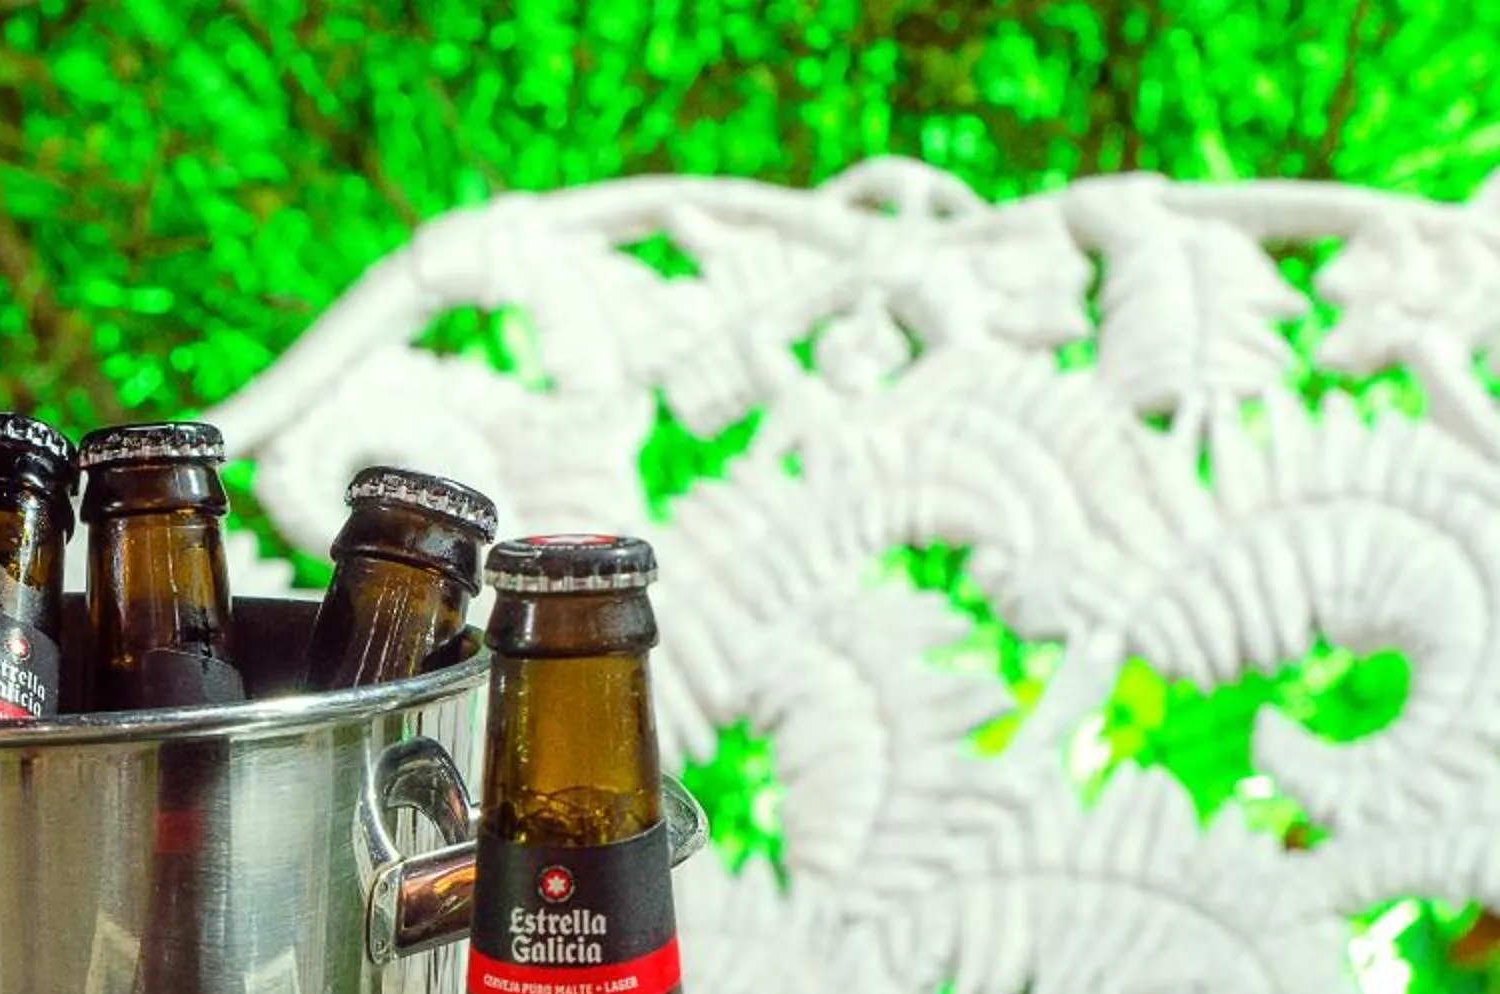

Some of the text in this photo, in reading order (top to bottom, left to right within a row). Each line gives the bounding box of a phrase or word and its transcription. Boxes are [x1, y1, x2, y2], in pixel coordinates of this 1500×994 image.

[509, 906, 607, 936] Estrella
[511, 935, 603, 965] Galicia
[483, 973, 520, 994] CERVEJA
[604, 975, 639, 993] LAGER
